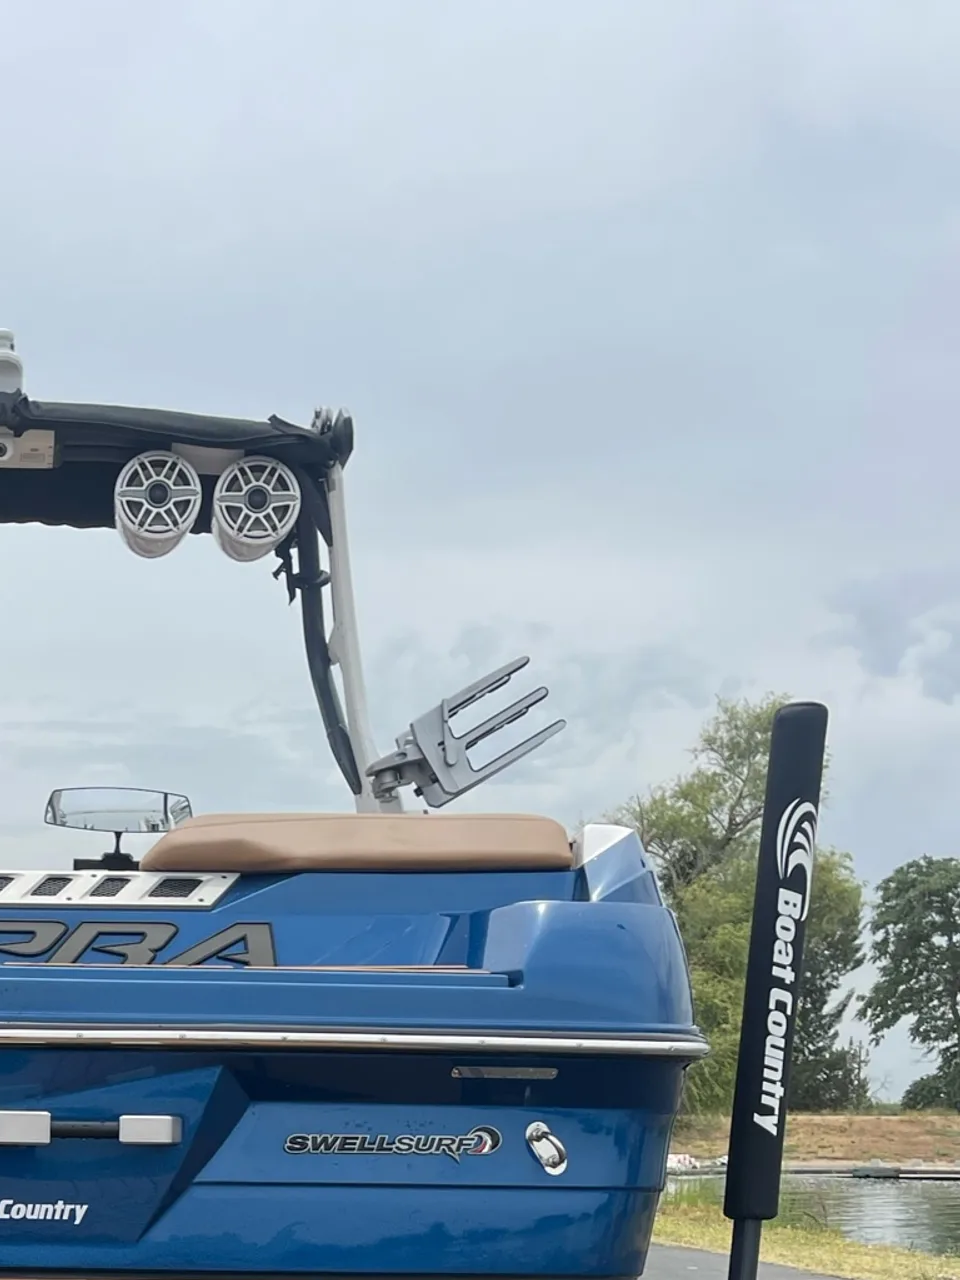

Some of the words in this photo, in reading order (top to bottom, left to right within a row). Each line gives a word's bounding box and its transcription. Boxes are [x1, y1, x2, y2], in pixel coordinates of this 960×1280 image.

[772, 887, 803, 985] Boat
[753, 987, 793, 1136] Country
[285, 1133, 481, 1164] SWELLSURF
